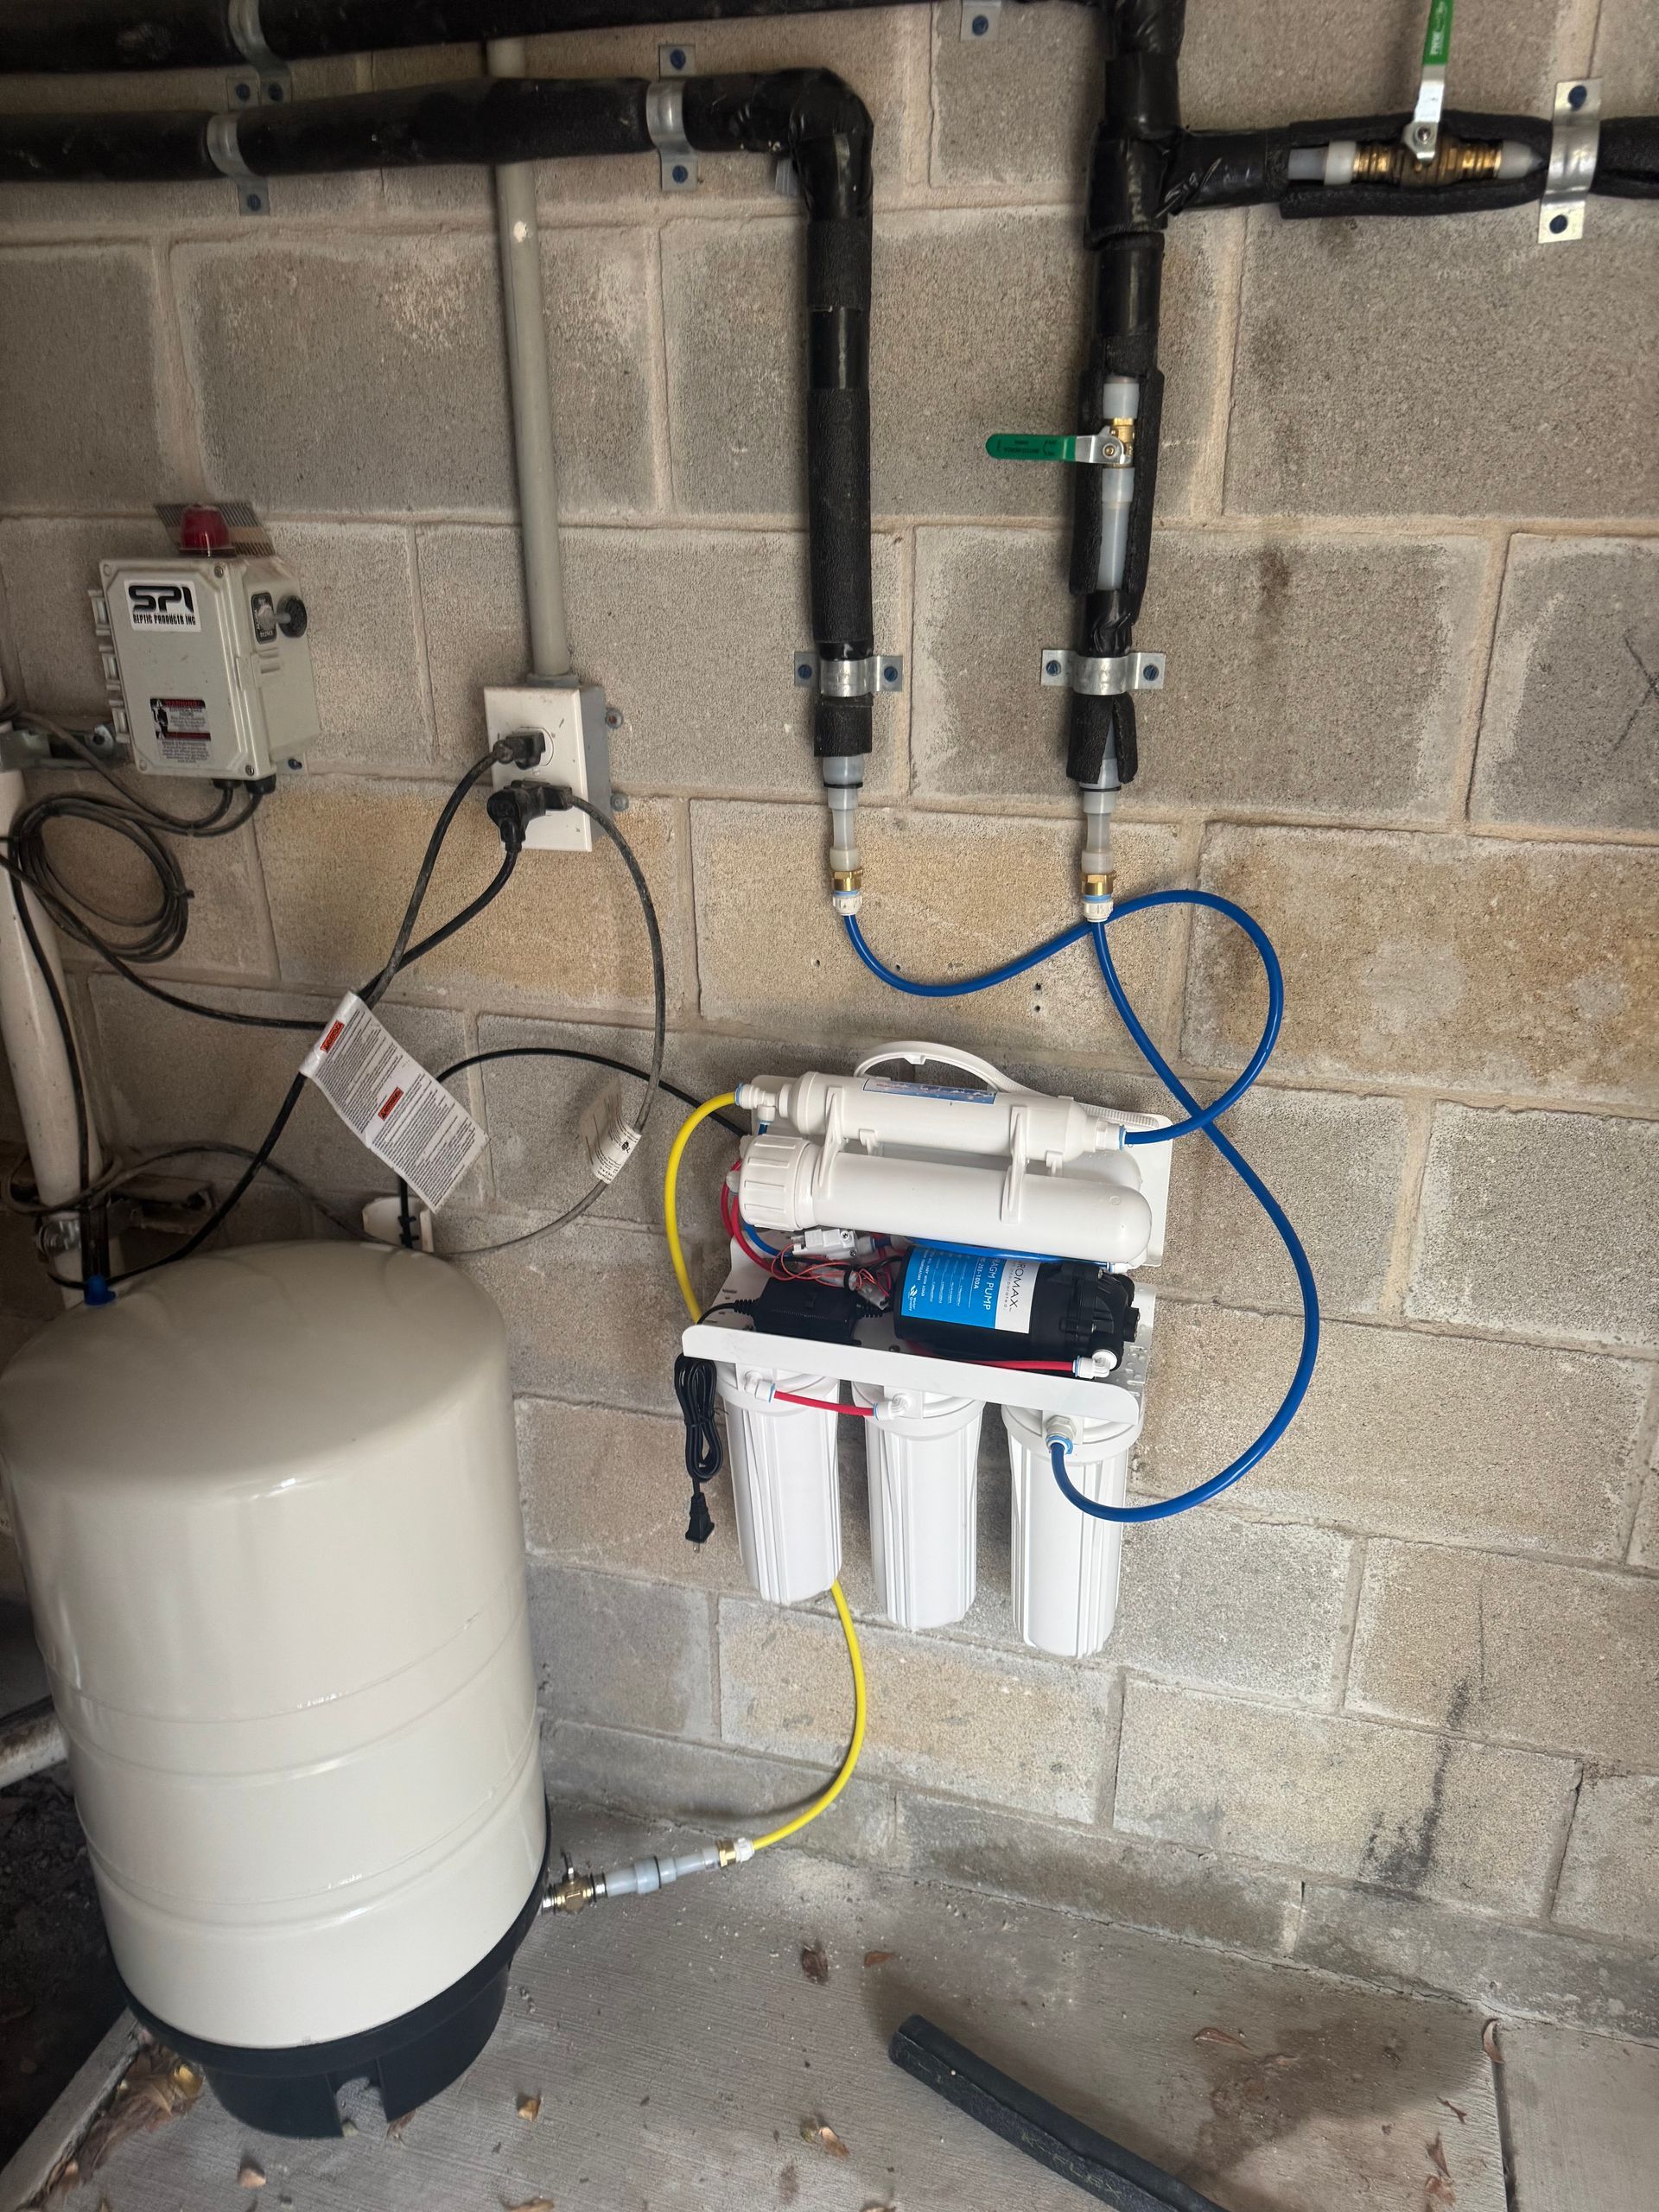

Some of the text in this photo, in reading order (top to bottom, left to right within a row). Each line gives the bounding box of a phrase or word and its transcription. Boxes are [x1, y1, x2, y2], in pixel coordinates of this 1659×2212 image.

[129, 585, 194, 613] SPI
[132, 613, 196, 626] SEPTIC PRODUCTS INC
[983, 1281, 995, 1311] PUMP
[1009, 1261, 1026, 1308] ROMAX
